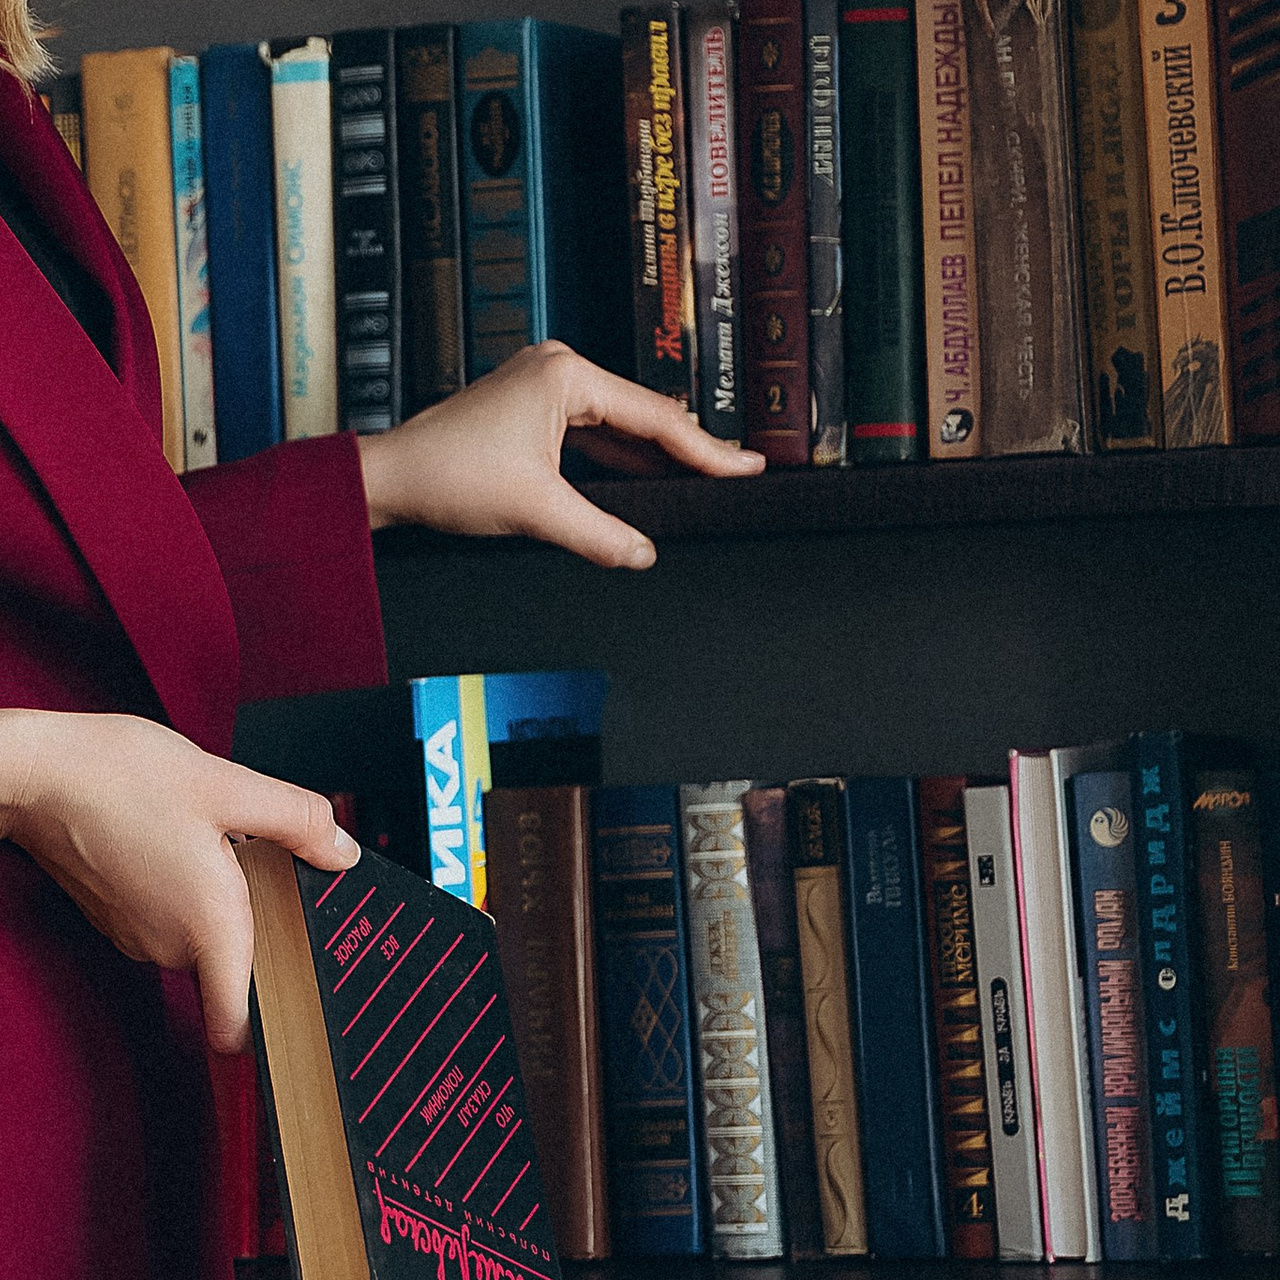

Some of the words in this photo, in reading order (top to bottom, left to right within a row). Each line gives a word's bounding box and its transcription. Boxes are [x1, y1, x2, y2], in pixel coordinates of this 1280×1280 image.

[648, 20, 676, 110] правил
[931, 3, 966, 143] НАДЕЖДЫ
[648, 114, 674, 152] без
[702, 26, 730, 198] ПОВЕЛИТЕЛЬ
[653, 160, 681, 209] игре
[938, 152, 968, 240] ПЕПЕЛ
[1150, 43, 1206, 298] В.О.Ключевский
[641, 224, 659, 286] Галина
[710, 210, 735, 317] Джексон
[1014, 222, 1033, 326] ЖЕНСКАЯ
[655, 233, 684, 361] Женщины
[940, 254, 972, 376] АБДУЛЛАЕВ
[714, 321, 736, 412] Мелани
[944, 381, 971, 402] Ч.
[1017, 334, 1035, 400] ЧЕСТЬ
[424, 718, 467, 892] ИКА
[1142, 764, 1178, 990] Олдридж
[335, 915, 373, 968] КРАСНОЕ
[381, 933, 401, 963] ВСЕ
[1093, 889, 1125, 951] РОМАН
[420, 1064, 465, 1127] ПОКОЙНИК
[459, 1080, 492, 1129] СКАЗАЛ
[497, 1103, 516, 1130] ЧТО
[1156, 1017, 1190, 1221] Джеймс
[366, 1159, 454, 1212] детектив
[962, 1192, 983, 1218] 4
[463, 1211, 551, 1263] польский
